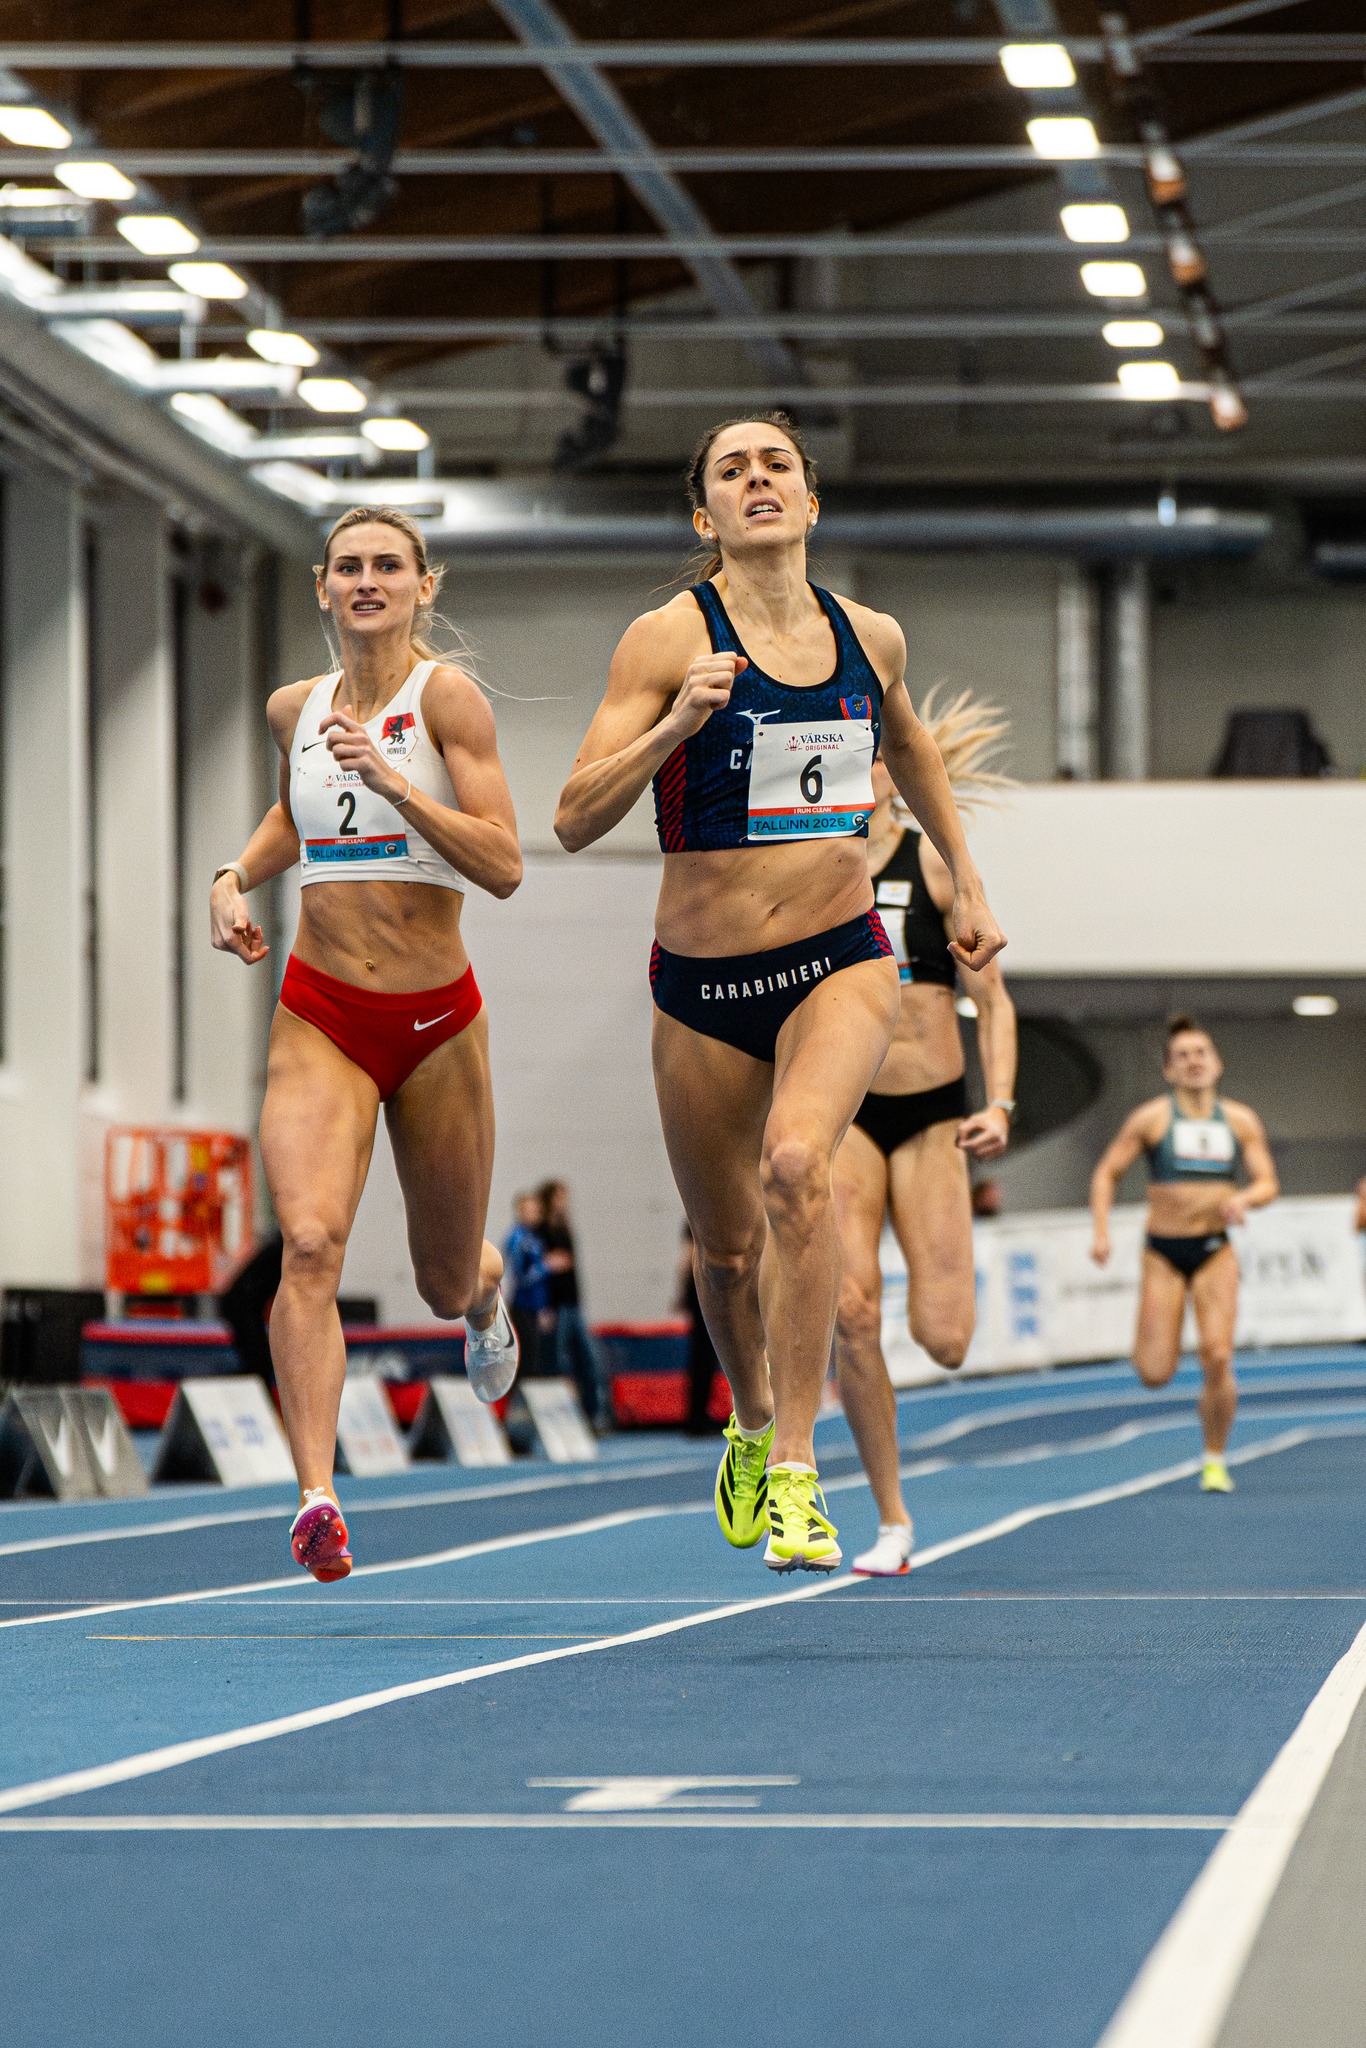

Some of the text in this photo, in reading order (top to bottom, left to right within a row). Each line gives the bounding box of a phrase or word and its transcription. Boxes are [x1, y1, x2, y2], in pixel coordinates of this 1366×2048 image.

[800, 732, 845, 744] VÄRSKA
[386, 746, 407, 755] HONVÉD
[800, 754, 824, 804] 6
[337, 791, 358, 836] 2
[754, 817, 847, 831] TALLINN 2026
[309, 847, 379, 859] TALLINN 2026
[701, 956, 832, 1000] CARABINIERI
